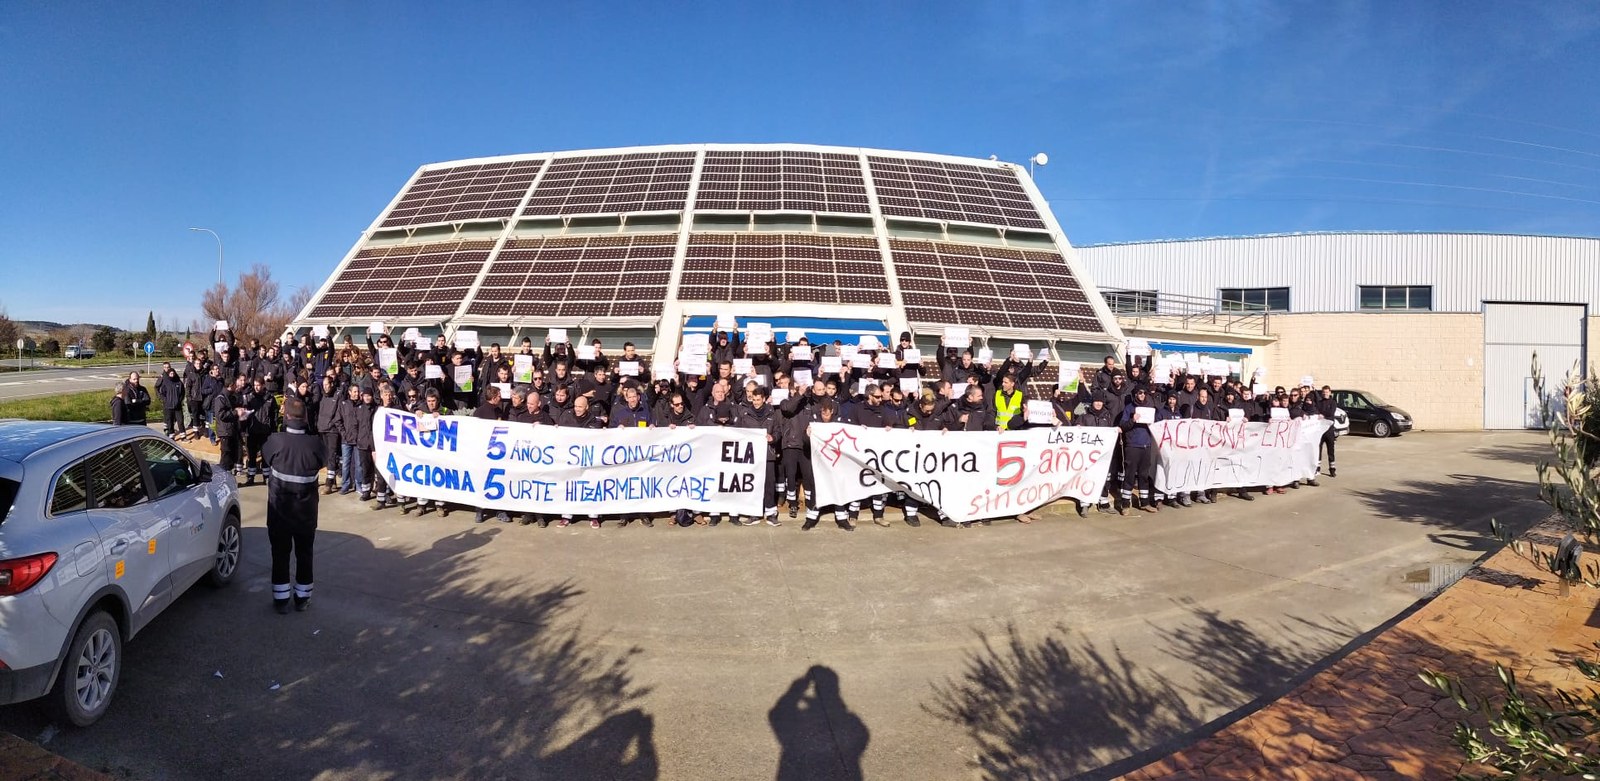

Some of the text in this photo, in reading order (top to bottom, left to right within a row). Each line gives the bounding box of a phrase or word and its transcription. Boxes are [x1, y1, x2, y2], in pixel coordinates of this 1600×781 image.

[486, 426, 509, 461] 5
[510, 439, 555, 466] AÑOS
[567, 444, 595, 467] SIN
[601, 442, 693, 466] CONVENIO
[721, 440, 755, 465] ELA
[1048, 431, 1104, 446] LAB ELA
[386, 452, 475, 493] ACCIONA
[484, 468, 506, 500] 5
[509, 479, 557, 502] URTE
[666, 475, 716, 502] GABE
[863, 443, 980, 474] acciona
[996, 440, 1027, 486] 5
[718, 471, 755, 494] LAB
[967, 488, 1010, 516] sin
